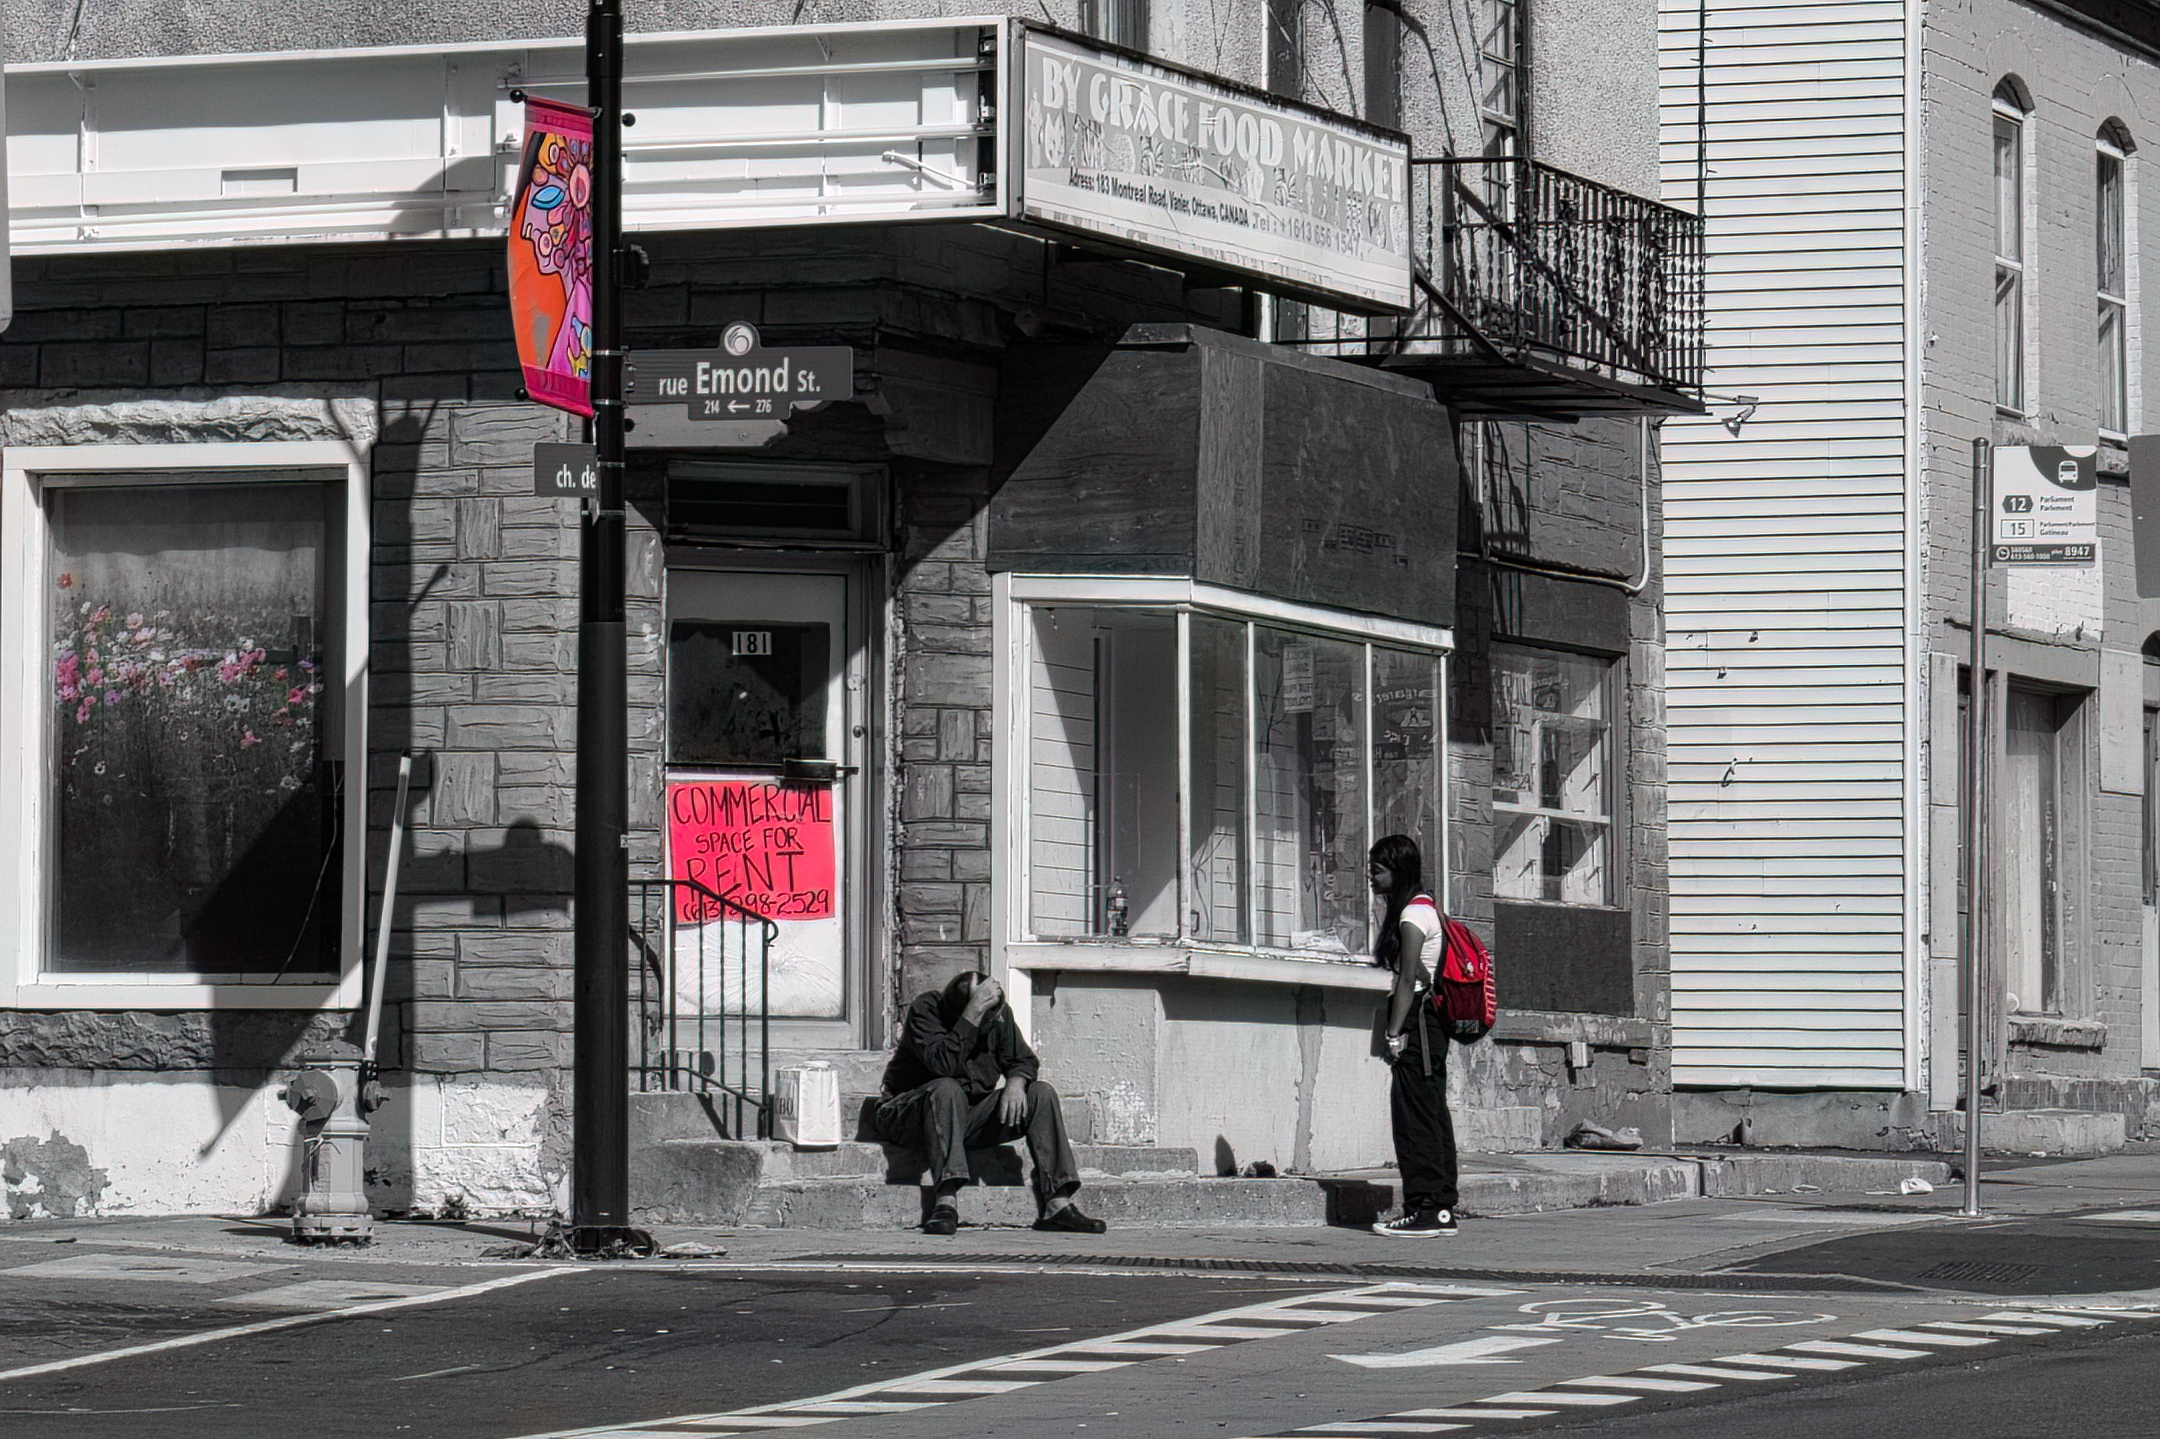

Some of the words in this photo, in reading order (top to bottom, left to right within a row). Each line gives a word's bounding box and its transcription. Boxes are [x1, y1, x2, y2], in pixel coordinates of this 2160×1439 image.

[1043, 57, 1081, 114] BY
[1089, 73, 1189, 145] GRACE
[1198, 101, 1284, 166] FOOD
[1293, 126, 1404, 202] MARKET
[1111, 177, 1146, 203] Montreal
[1219, 203, 1249, 228] CANADA
[658, 376, 688, 396] rue
[696, 357, 789, 395] Emond
[797, 371, 821, 393] St.
[704, 400, 720, 414] 214
[755, 398, 772, 414] 276
[556, 463, 576, 489] ch.
[2009, 496, 2027, 512] 12
[2010, 522, 2026, 536] 15
[2064, 545, 2090, 556] 8947
[736, 633, 768, 654] 181
[673, 783, 831, 827] COMMERCIAL
[695, 829, 755, 854] SPACE
[763, 827, 804, 850] FOR
[686, 850, 805, 902] RENT
